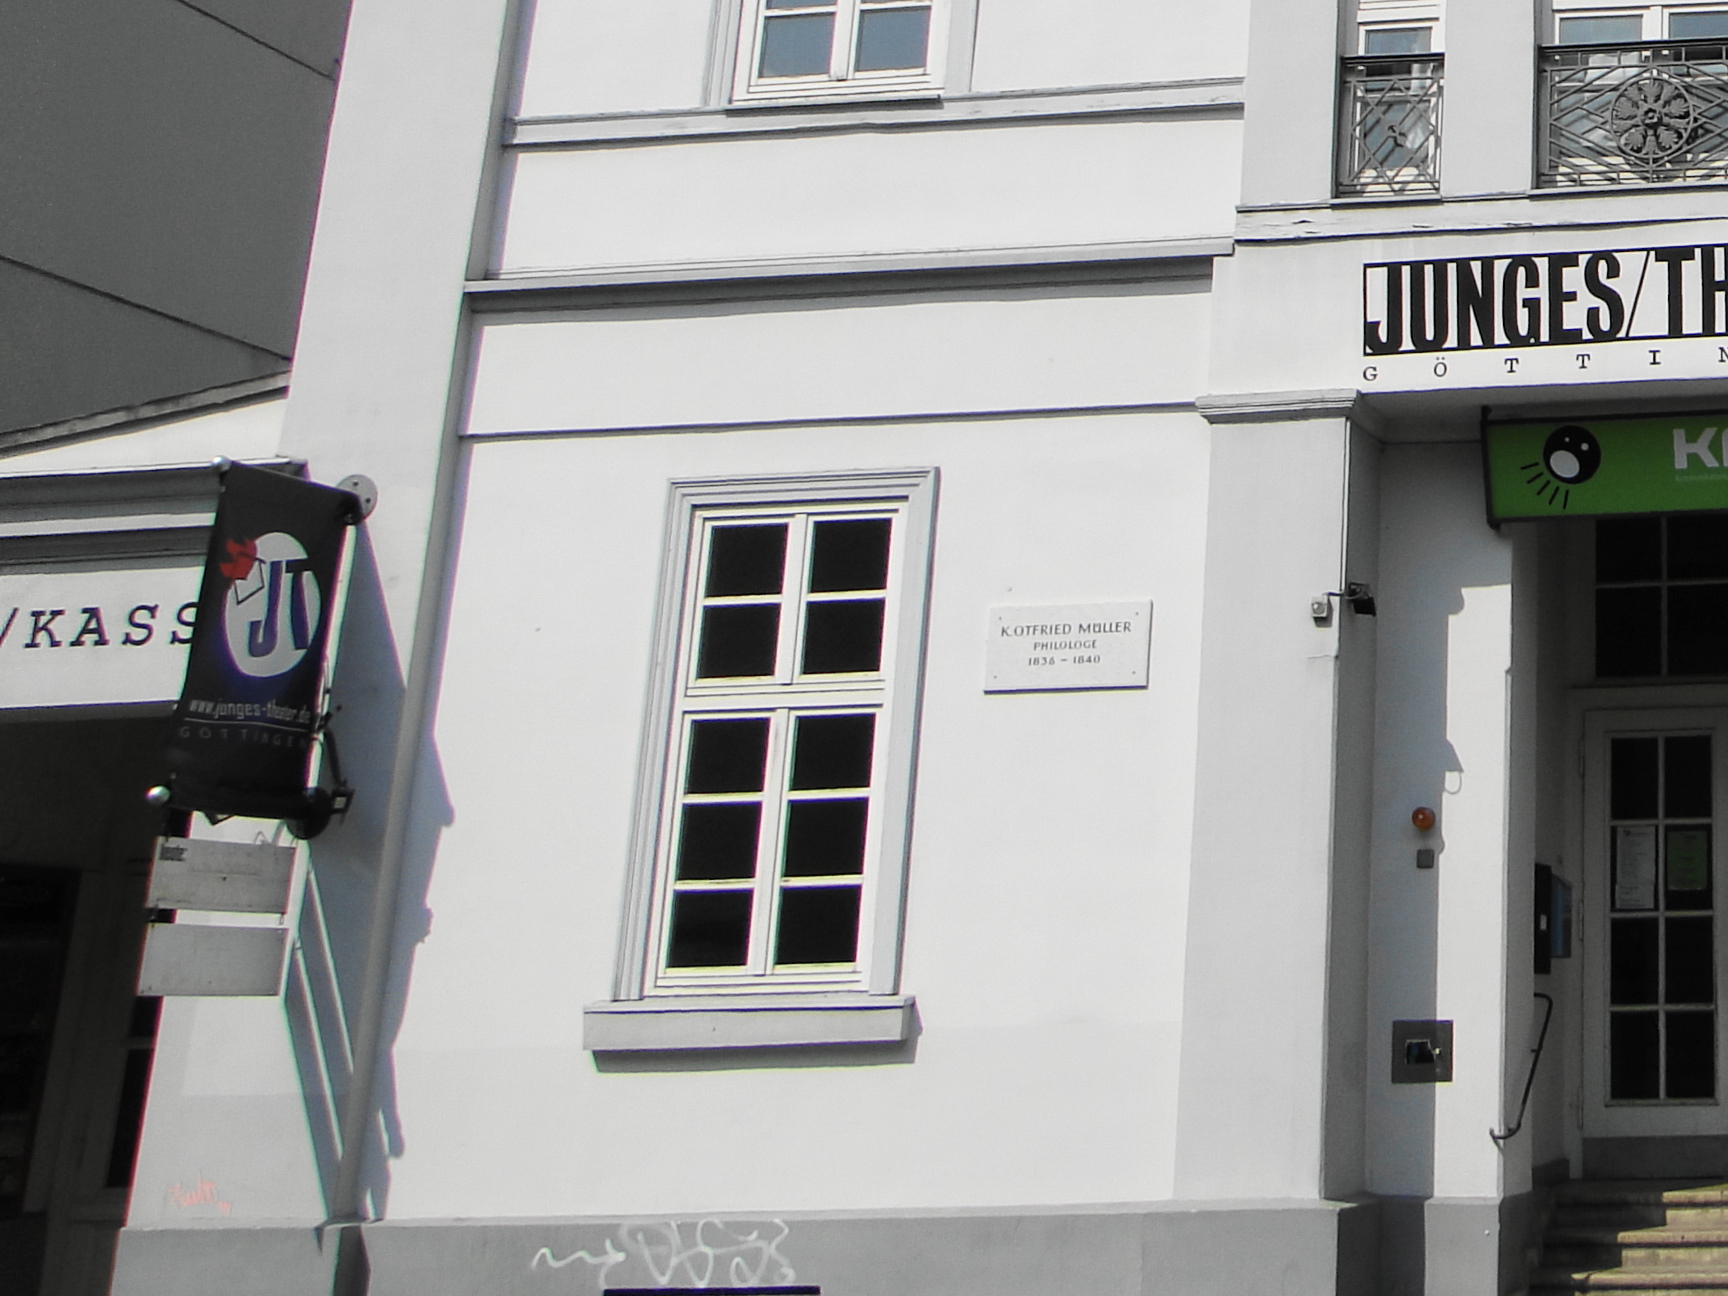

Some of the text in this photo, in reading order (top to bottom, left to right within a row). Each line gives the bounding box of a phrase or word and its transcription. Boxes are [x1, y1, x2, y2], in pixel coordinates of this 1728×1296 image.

[1078, 621, 1132, 635] MÜLLER
[1033, 639, 1098, 651] PHILOLOGE
[1073, 654, 1101, 665] 1840
[188, 698, 311, 724] www.junges-theater.de
